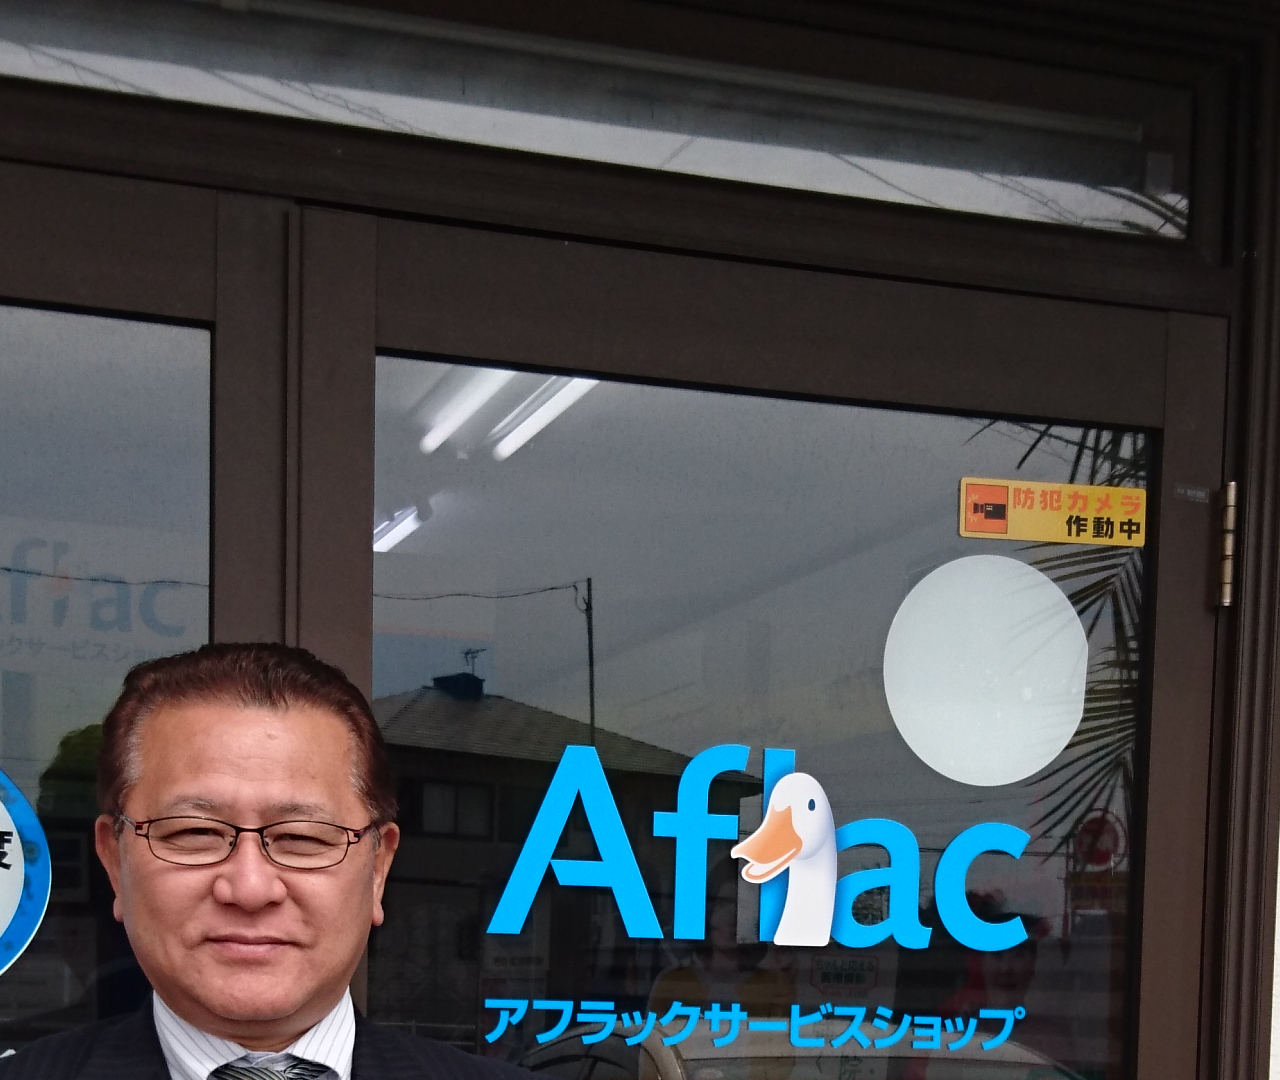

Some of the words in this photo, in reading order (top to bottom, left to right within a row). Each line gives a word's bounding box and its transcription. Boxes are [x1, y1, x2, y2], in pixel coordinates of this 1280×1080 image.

[1012, 486, 1142, 516] 防犯カメラ
[1065, 514, 1142, 541] 作動中
[485, 743, 1032, 953] Aflac
[483, 997, 1027, 1053] アフラックサービスショップ
